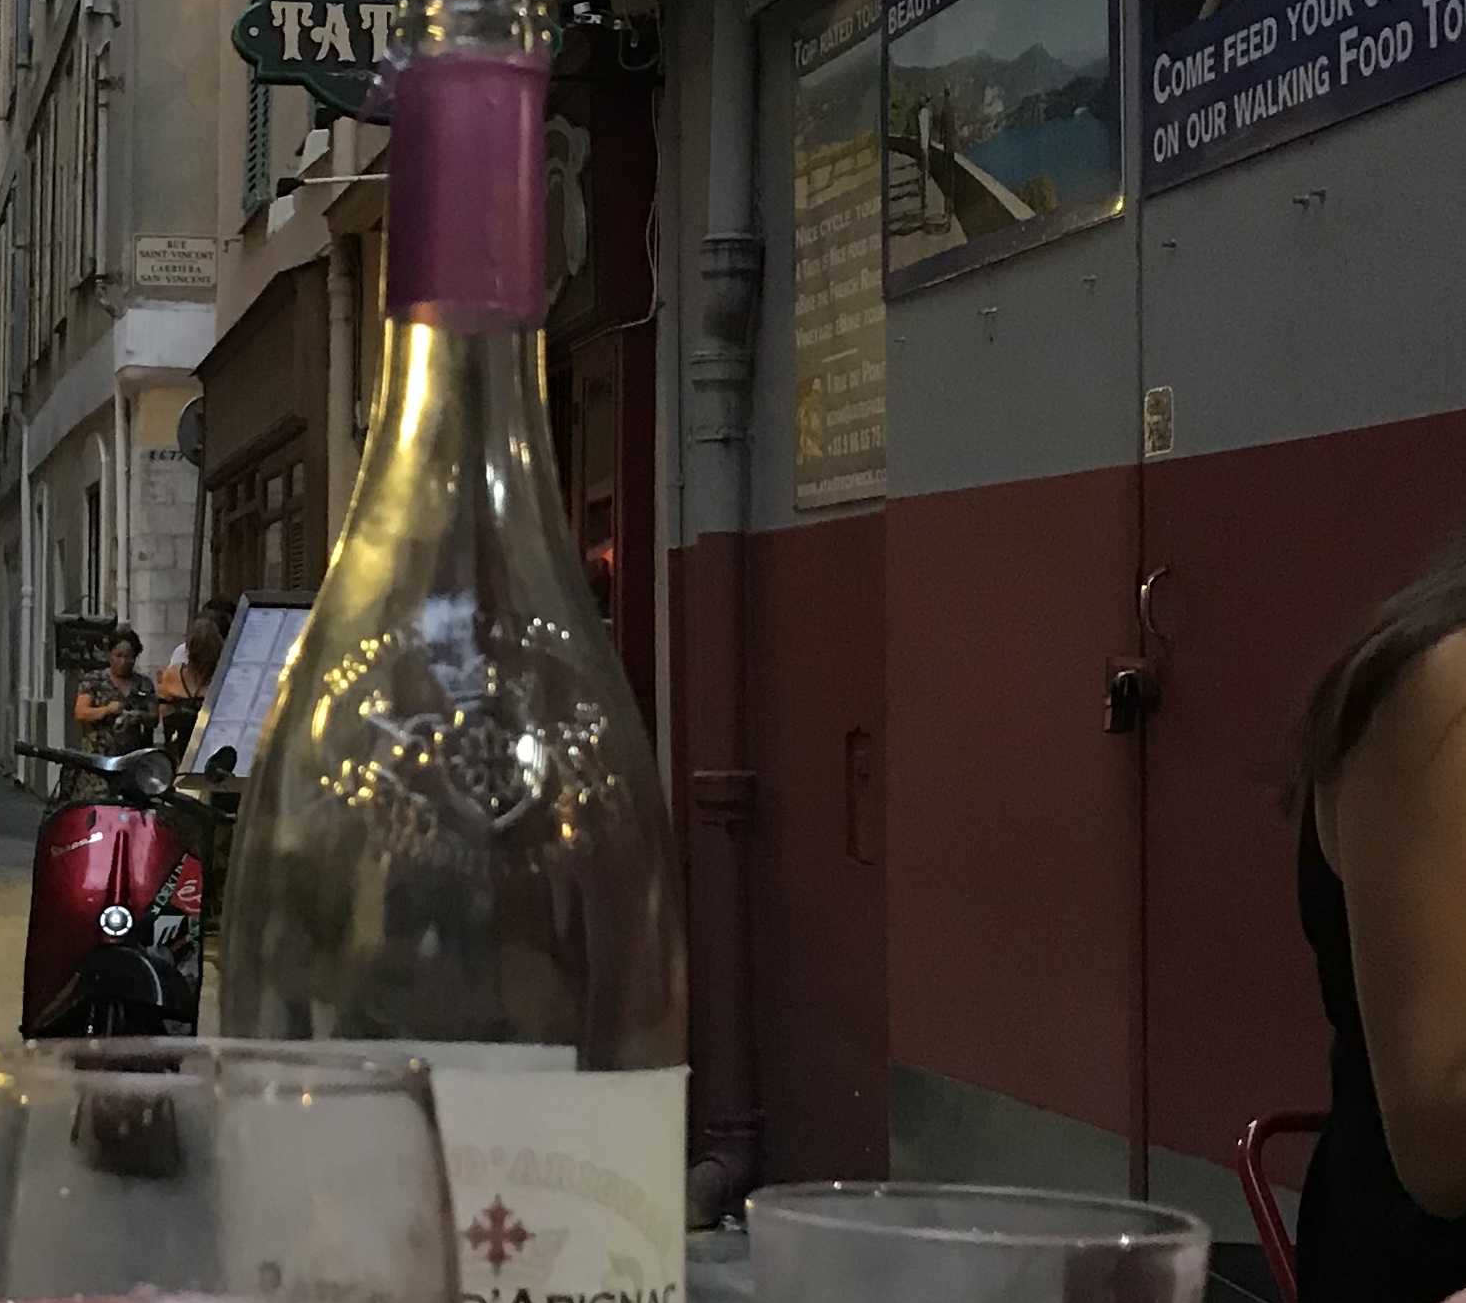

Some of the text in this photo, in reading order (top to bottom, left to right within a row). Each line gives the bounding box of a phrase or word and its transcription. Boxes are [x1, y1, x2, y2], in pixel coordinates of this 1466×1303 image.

[269, 0, 400, 63] TAT
[794, 37, 819, 70] TOP
[820, 16, 853, 56] RATED
[1153, 45, 1216, 104] COME
[1223, 17, 1278, 73] FEED
[1153, 121, 1180, 163] ON
[1186, 101, 1227, 149] OUR
[1233, 55, 1330, 129] WALKING
[1339, 20, 1414, 85] FOOD
[167, 240, 186, 249] RUE
